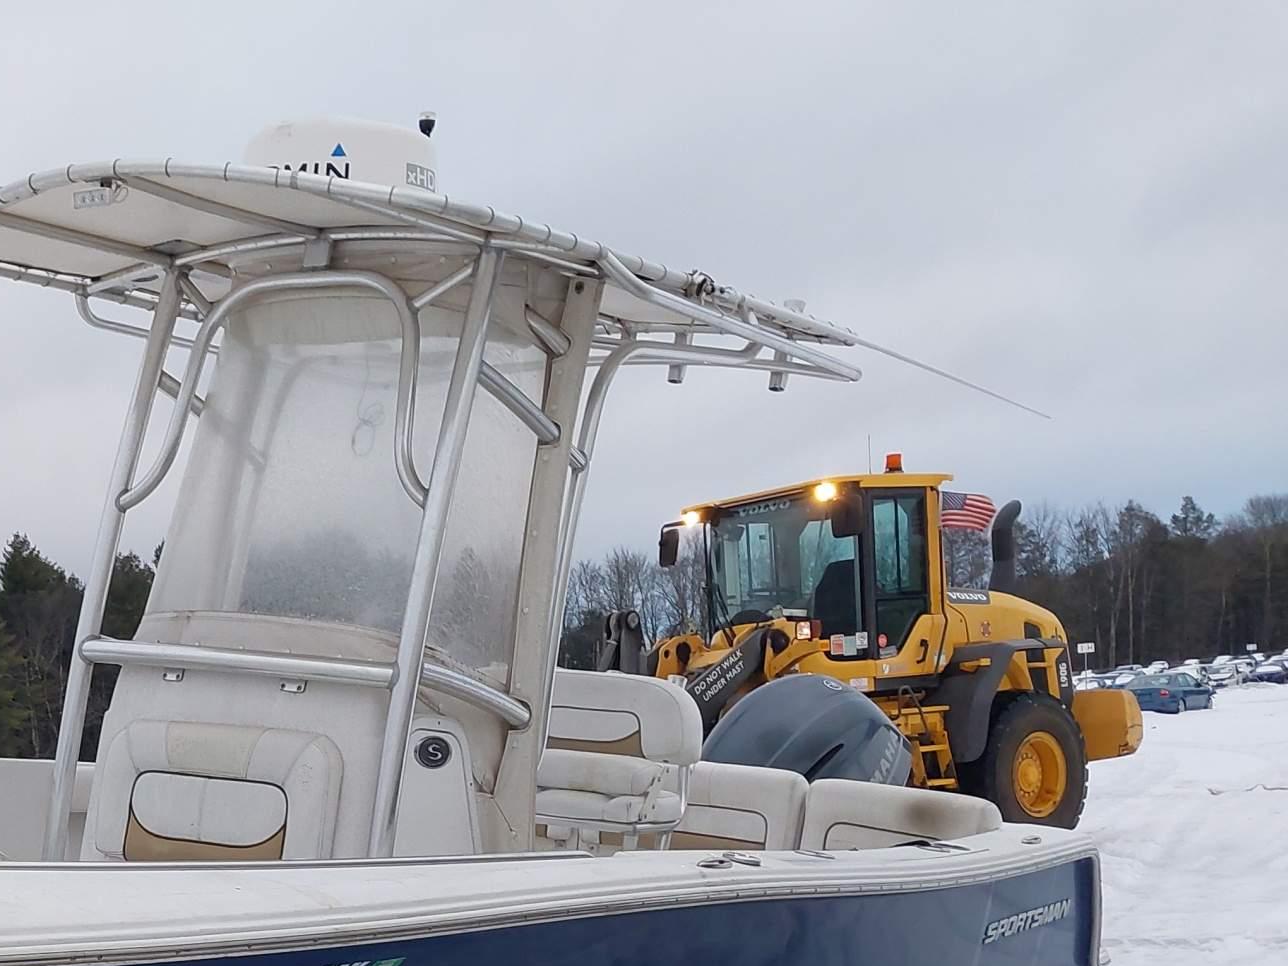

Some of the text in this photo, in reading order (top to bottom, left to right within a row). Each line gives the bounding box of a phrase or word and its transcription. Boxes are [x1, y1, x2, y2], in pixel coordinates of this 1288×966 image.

[738, 500, 791, 517] VOLVO
[947, 591, 988, 601] VOLVO
[694, 648, 743, 695] DO NOT WALK
[702, 661, 745, 702] UNDER MAST
[982, 898, 1072, 944] SPORTSMAN
